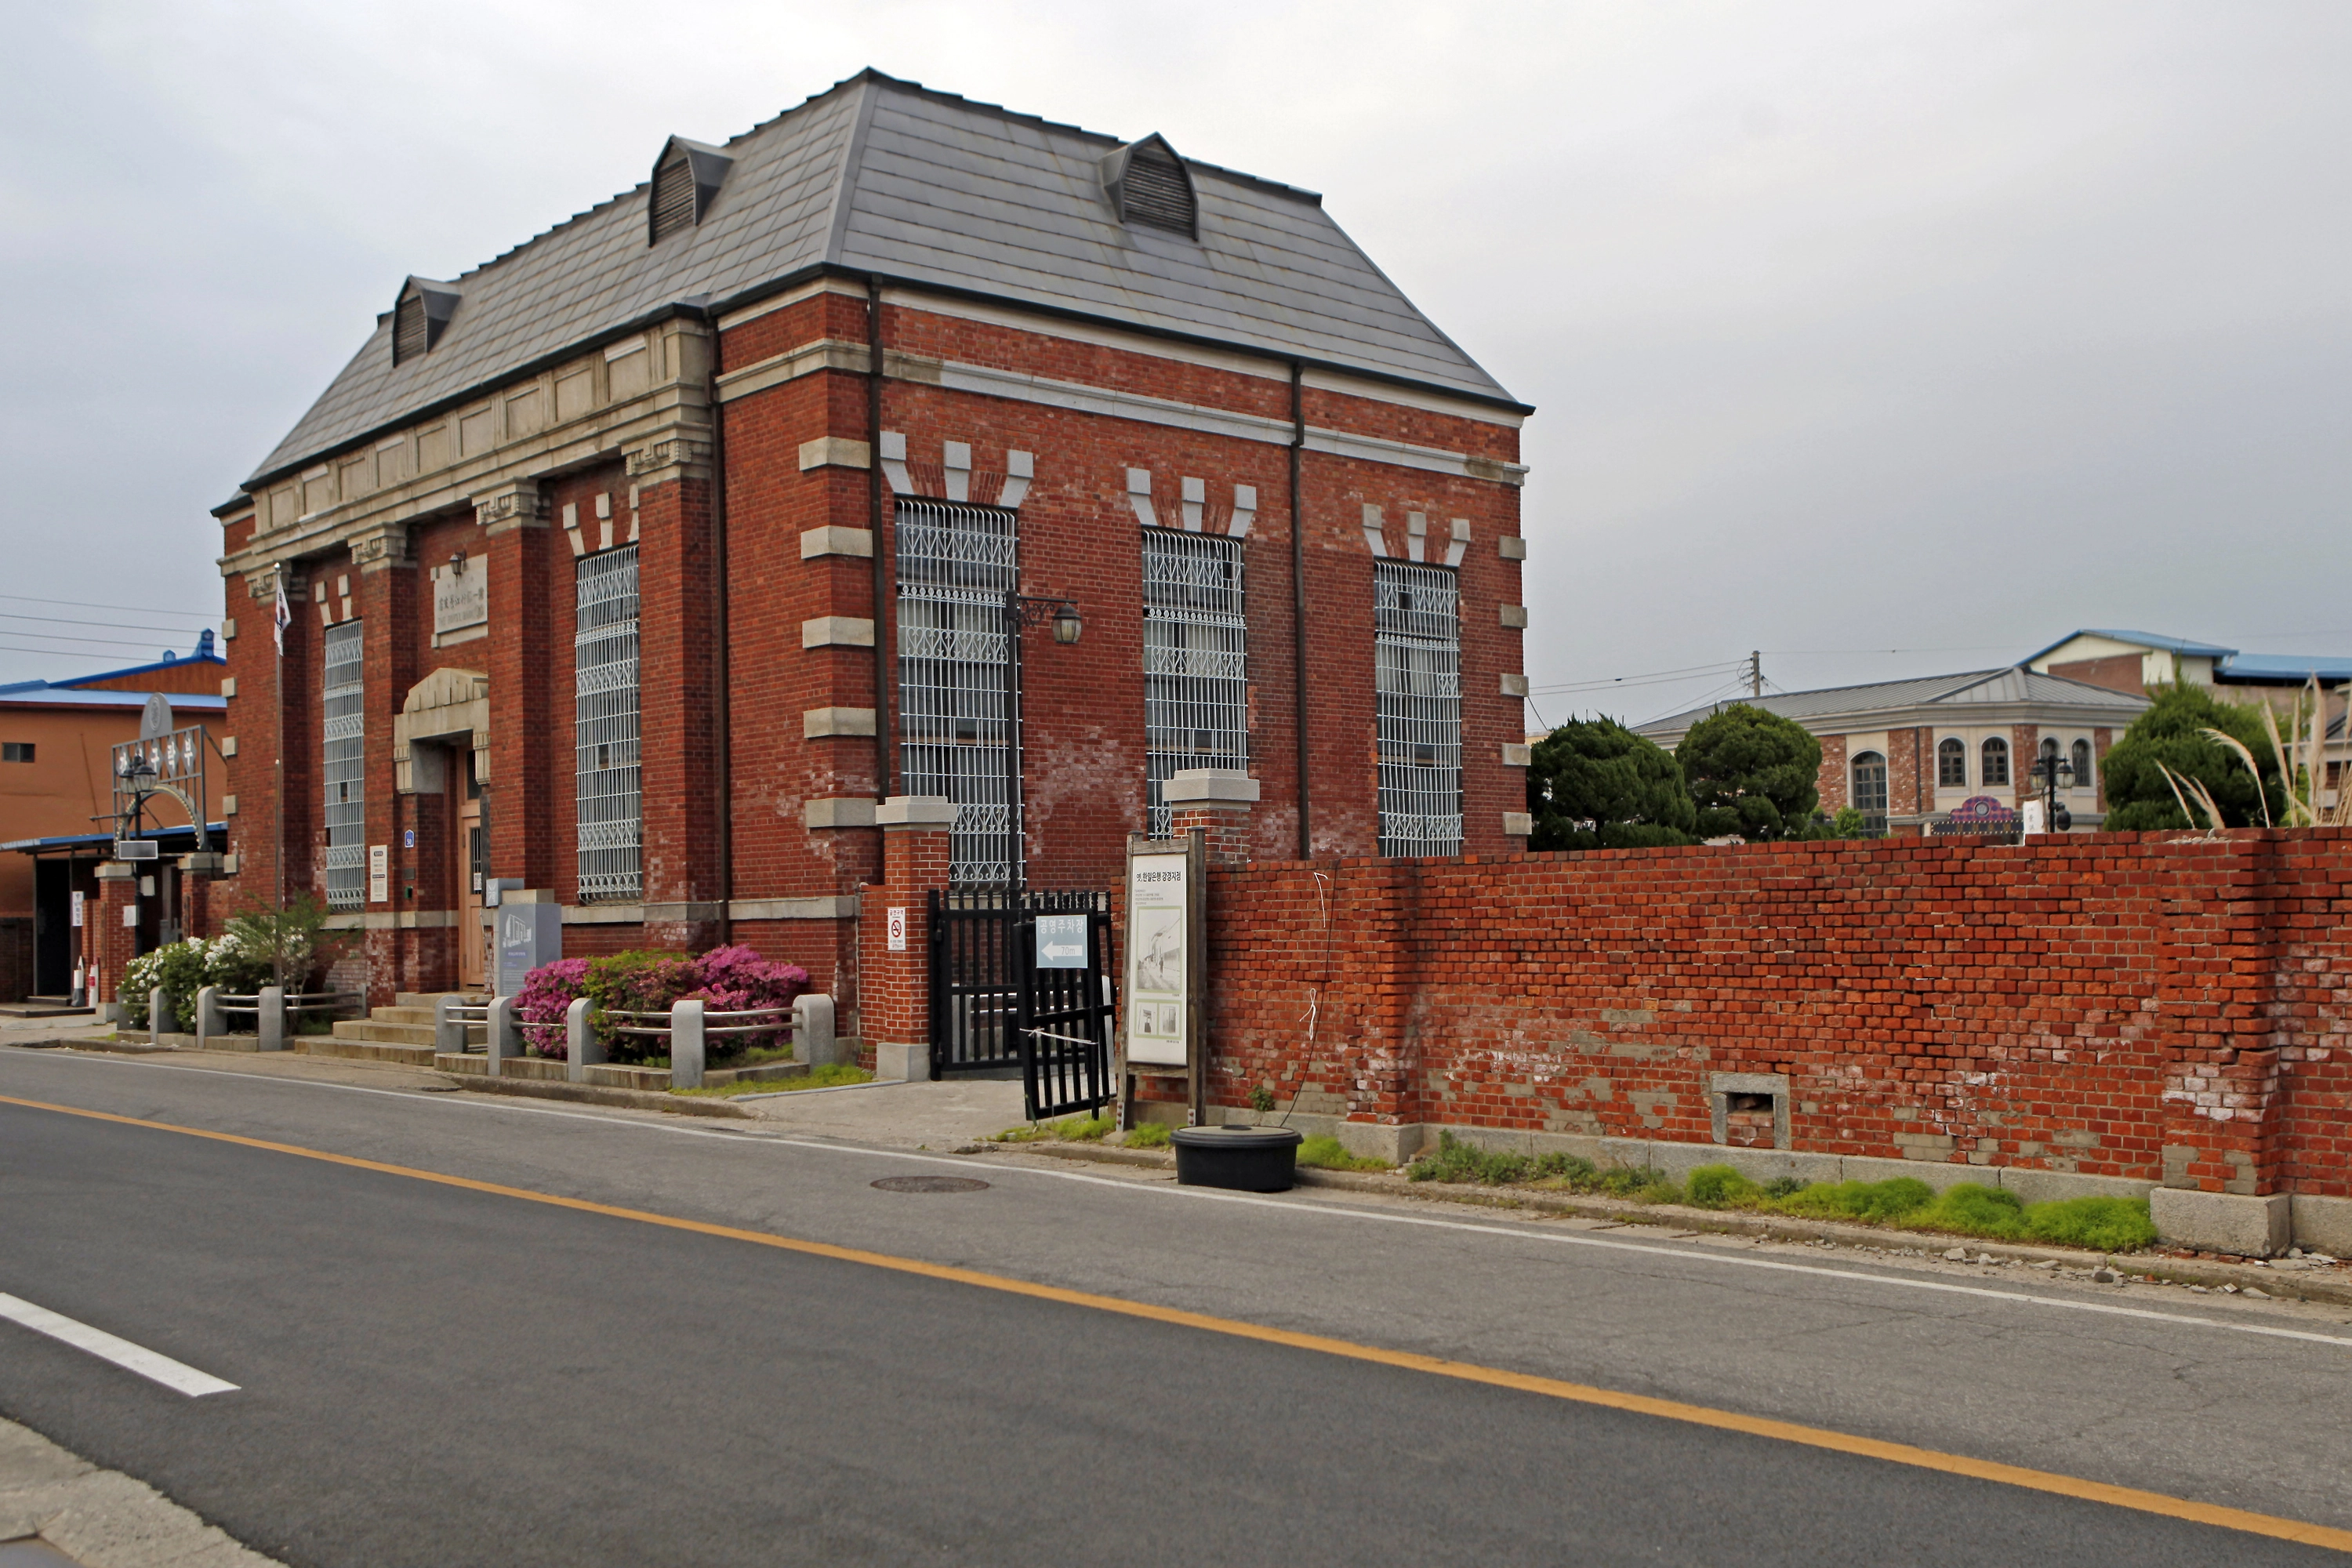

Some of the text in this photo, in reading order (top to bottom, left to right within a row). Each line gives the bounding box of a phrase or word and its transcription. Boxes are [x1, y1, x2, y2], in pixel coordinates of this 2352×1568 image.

[119, 738, 194, 775] 강구락부
[1162, 871, 1181, 882] 강경지점
[1040, 918, 1084, 934] 공영주차장
[1061, 946, 1076, 956] 70m
